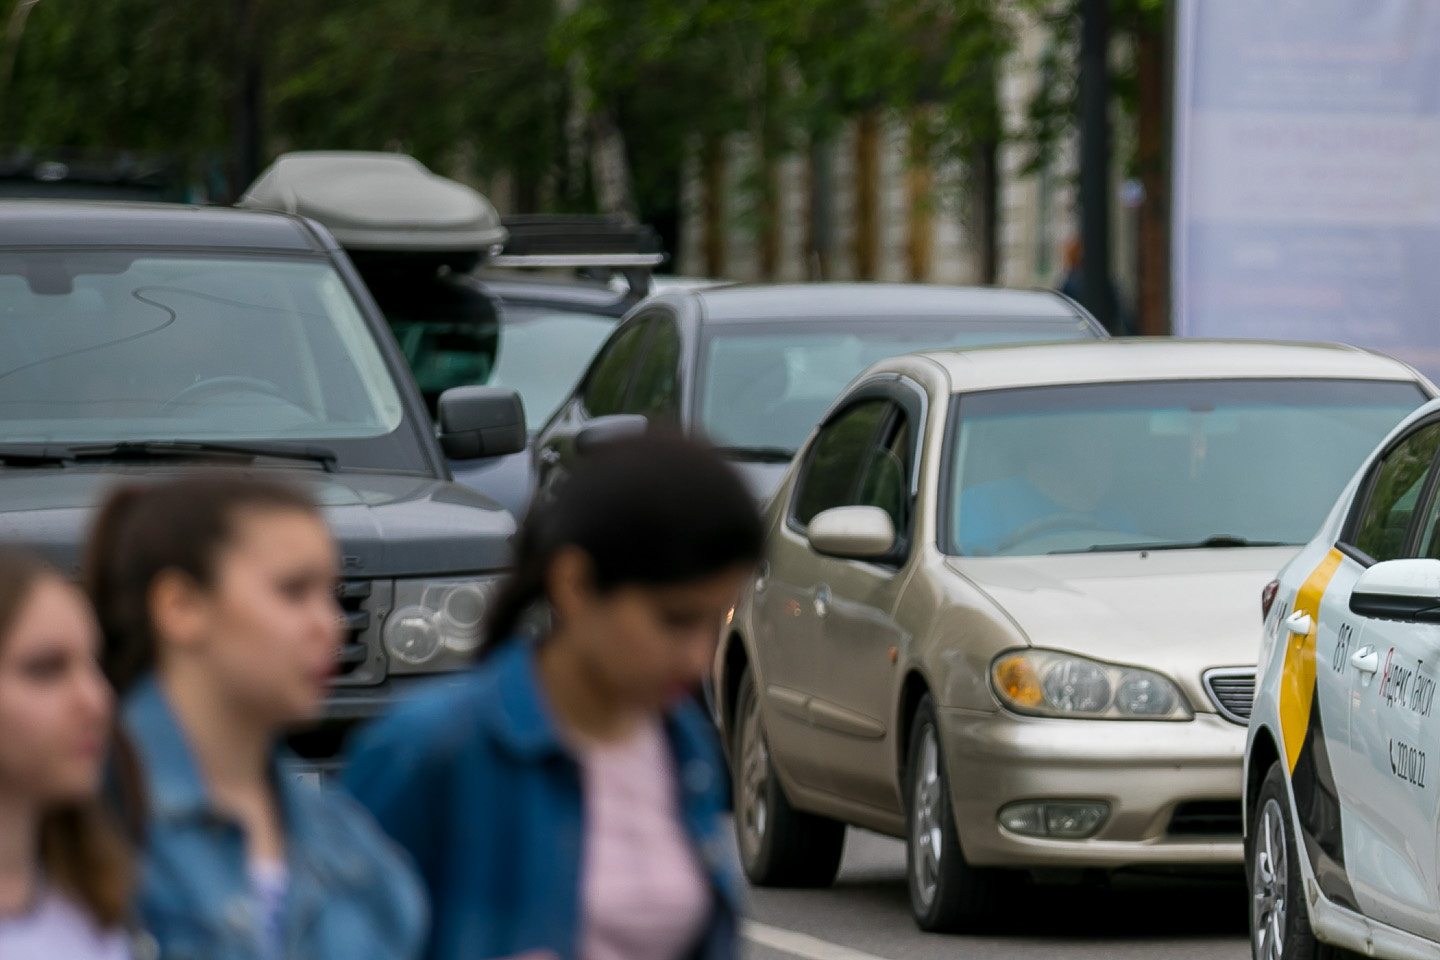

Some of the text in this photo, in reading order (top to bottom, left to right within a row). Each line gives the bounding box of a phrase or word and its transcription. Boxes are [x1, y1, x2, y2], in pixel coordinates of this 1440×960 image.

[1333, 622, 1353, 675] 851
[1379, 647, 1437, 718] Яндекс Такси
[1397, 741, 1408, 780] 222
[1417, 750, 1426, 788] 22
